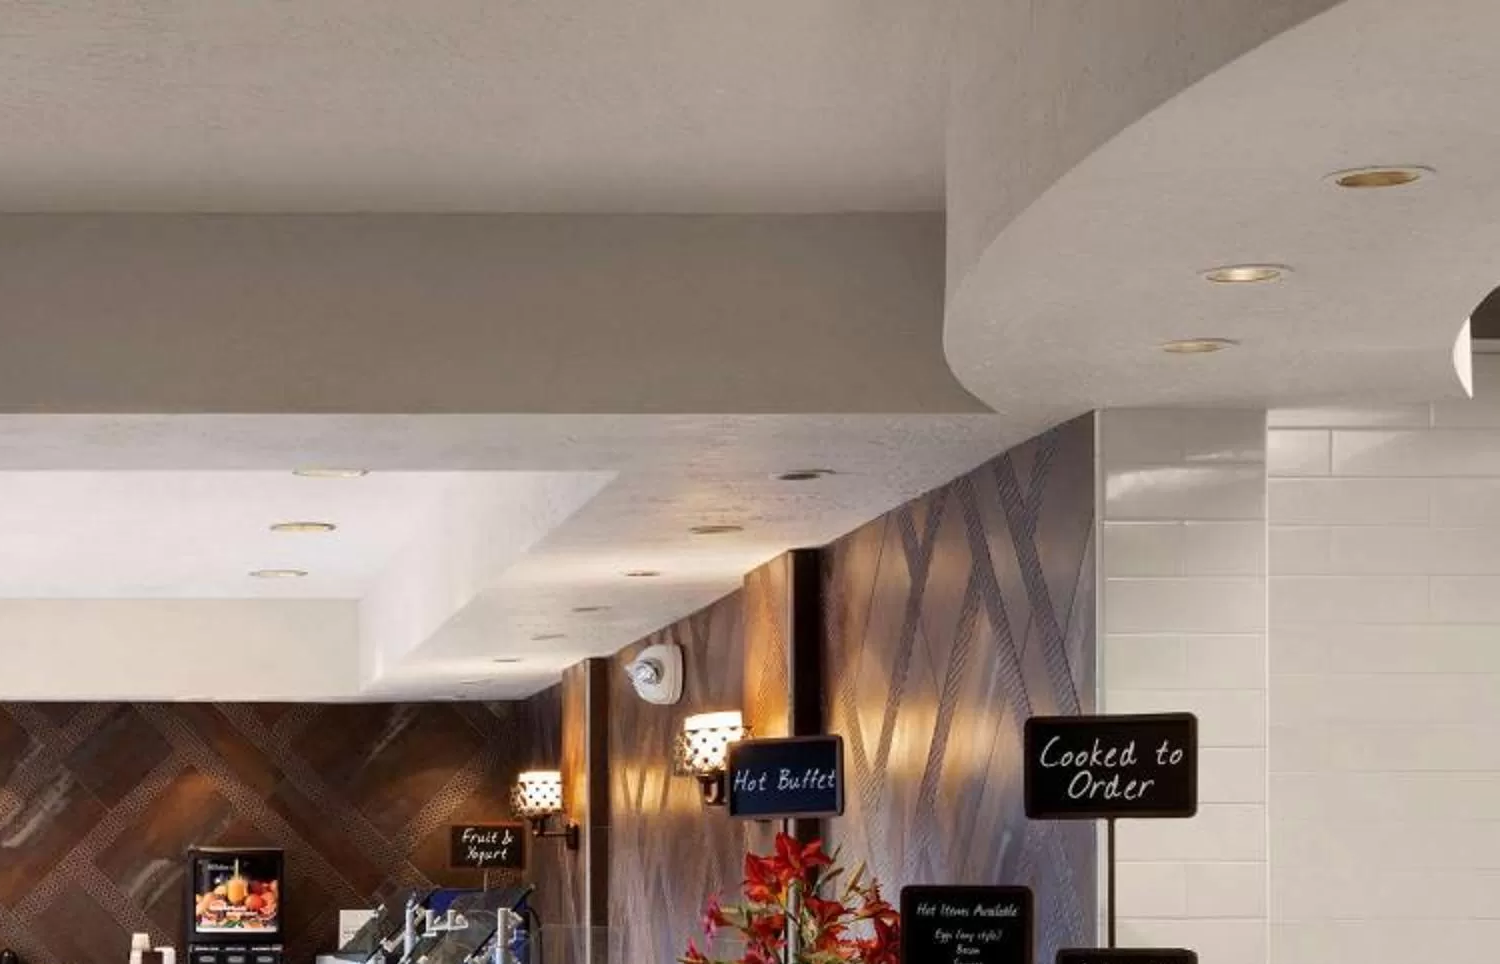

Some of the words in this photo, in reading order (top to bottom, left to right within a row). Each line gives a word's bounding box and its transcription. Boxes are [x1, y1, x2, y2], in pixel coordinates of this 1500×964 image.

[1040, 735, 1137, 768] Cooked
[1156, 739, 1183, 765] to
[733, 769, 768, 792] Hot
[777, 768, 836, 791] Buffet
[1068, 770, 1155, 800] Order
[461, 828, 499, 844] Fruit
[501, 829, 514, 845] &
[467, 845, 508, 866] Yogurt
[916, 902, 936, 917] Hot
[940, 903, 969, 917] Items
[973, 903, 1018, 917] Available
